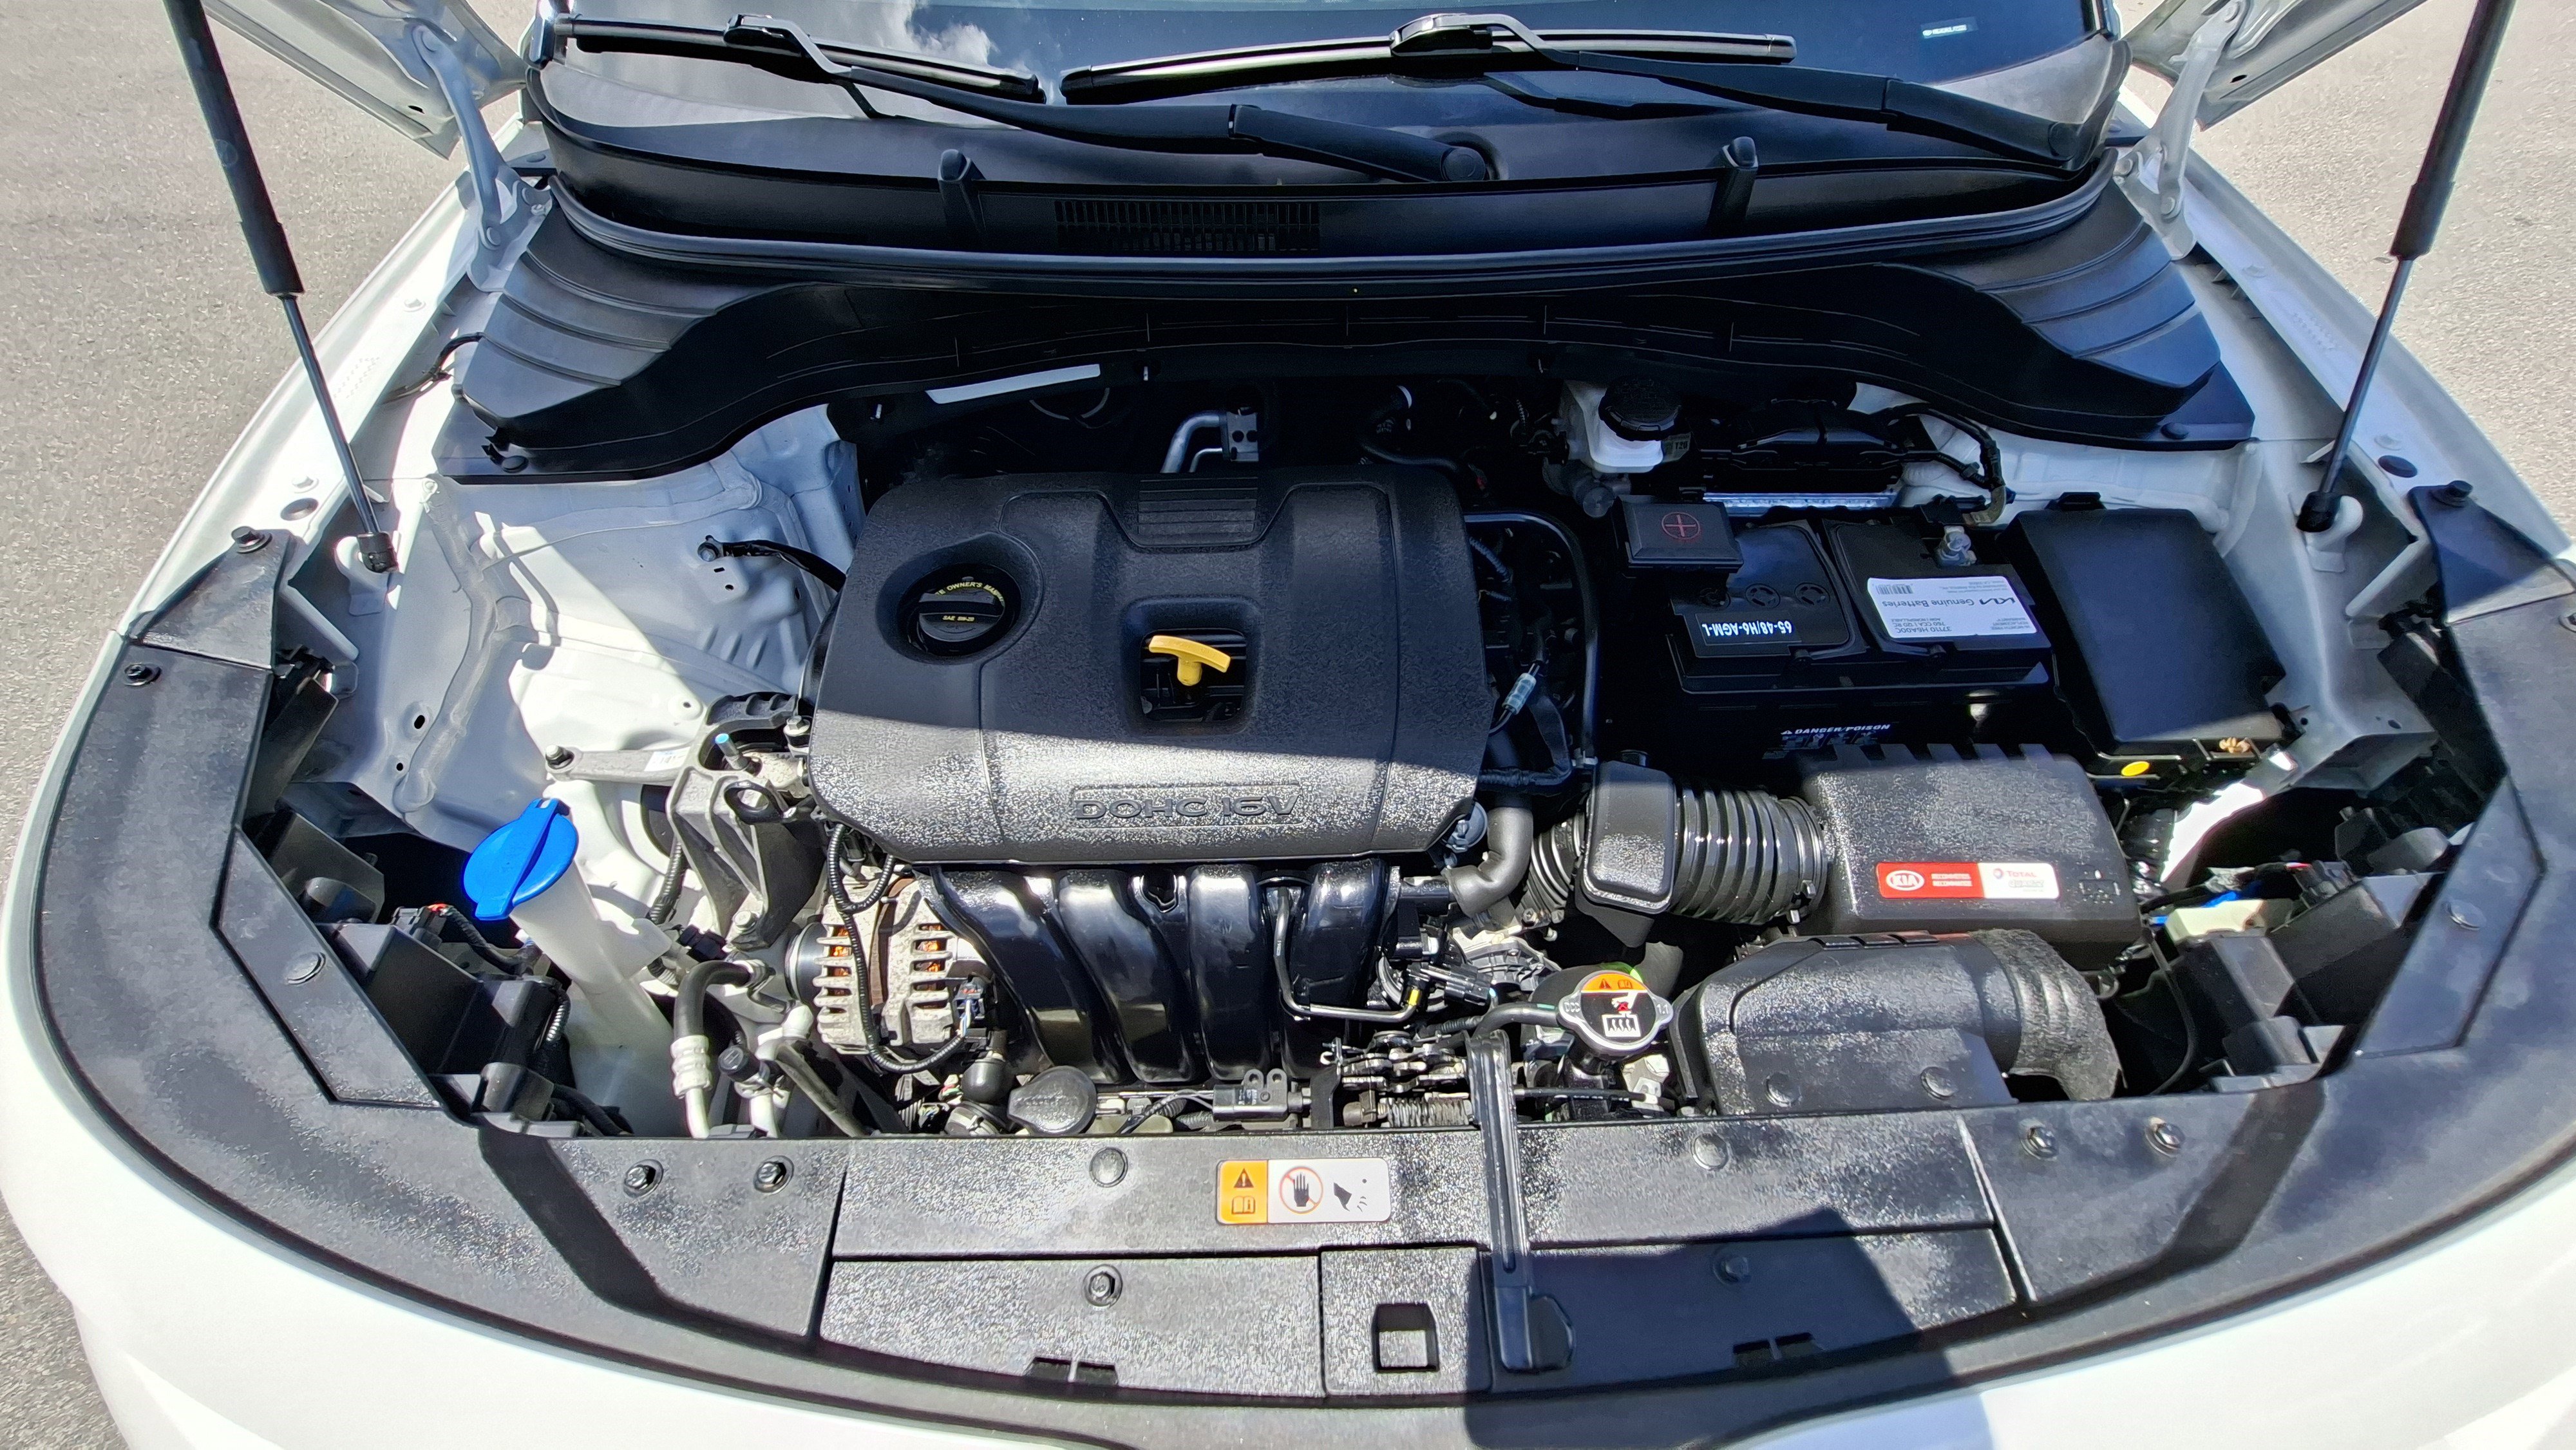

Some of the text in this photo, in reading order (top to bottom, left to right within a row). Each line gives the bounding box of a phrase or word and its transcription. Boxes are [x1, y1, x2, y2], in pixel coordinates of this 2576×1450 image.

[1882, 599, 1929, 608] Batteries
[1701, 621, 1792, 636] 65-48/H6-AGM-L
[1794, 724, 1891, 734] DANGER/POISON
[1075, 795, 1302, 819] DOHC 16V
[1656, 1004, 1669, 1014] 1.1
